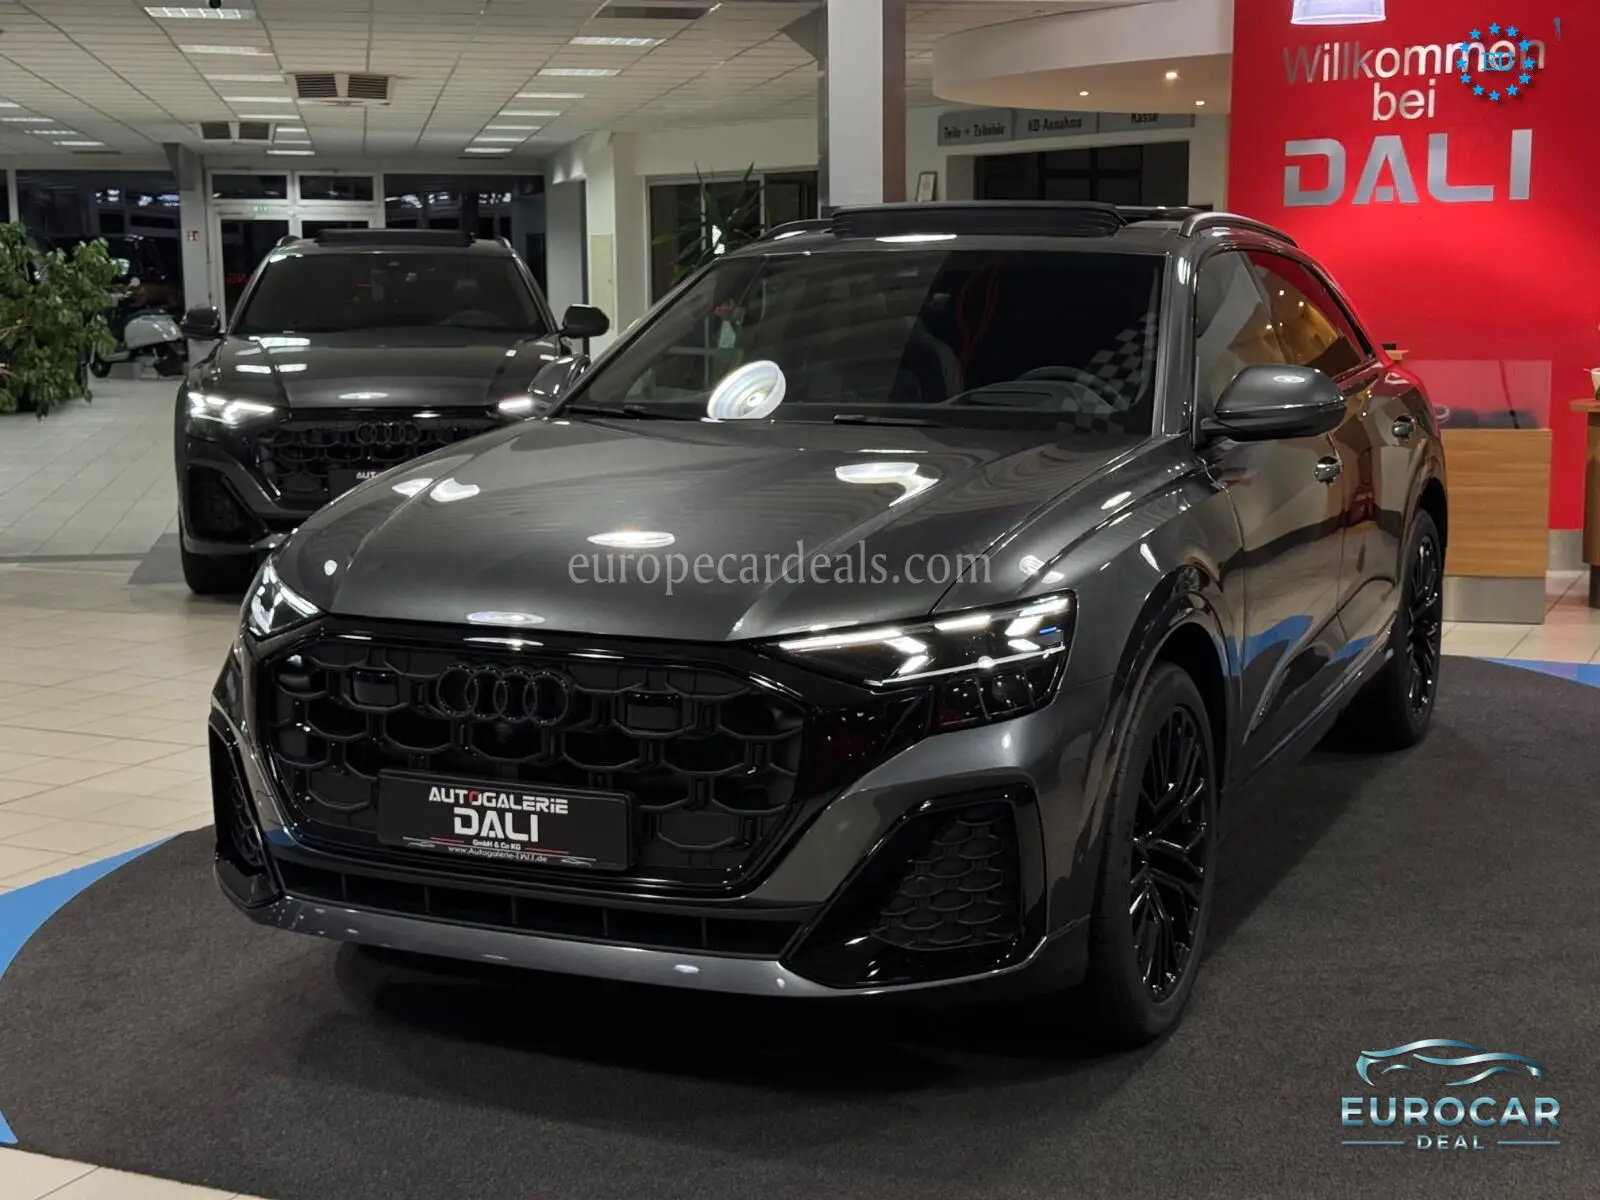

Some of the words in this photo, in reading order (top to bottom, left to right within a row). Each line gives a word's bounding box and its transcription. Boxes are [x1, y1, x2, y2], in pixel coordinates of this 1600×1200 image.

[1283, 39, 1546, 85] Willkommen
[1373, 78, 1436, 121] bei
[1283, 128, 1533, 207] DALI
[428, 786, 569, 815] AUTOGALERIE
[453, 806, 539, 843] DALI
[472, 839, 493, 848] GmbH
[494, 841, 500, 849] &
[510, 843, 521, 851] KG
